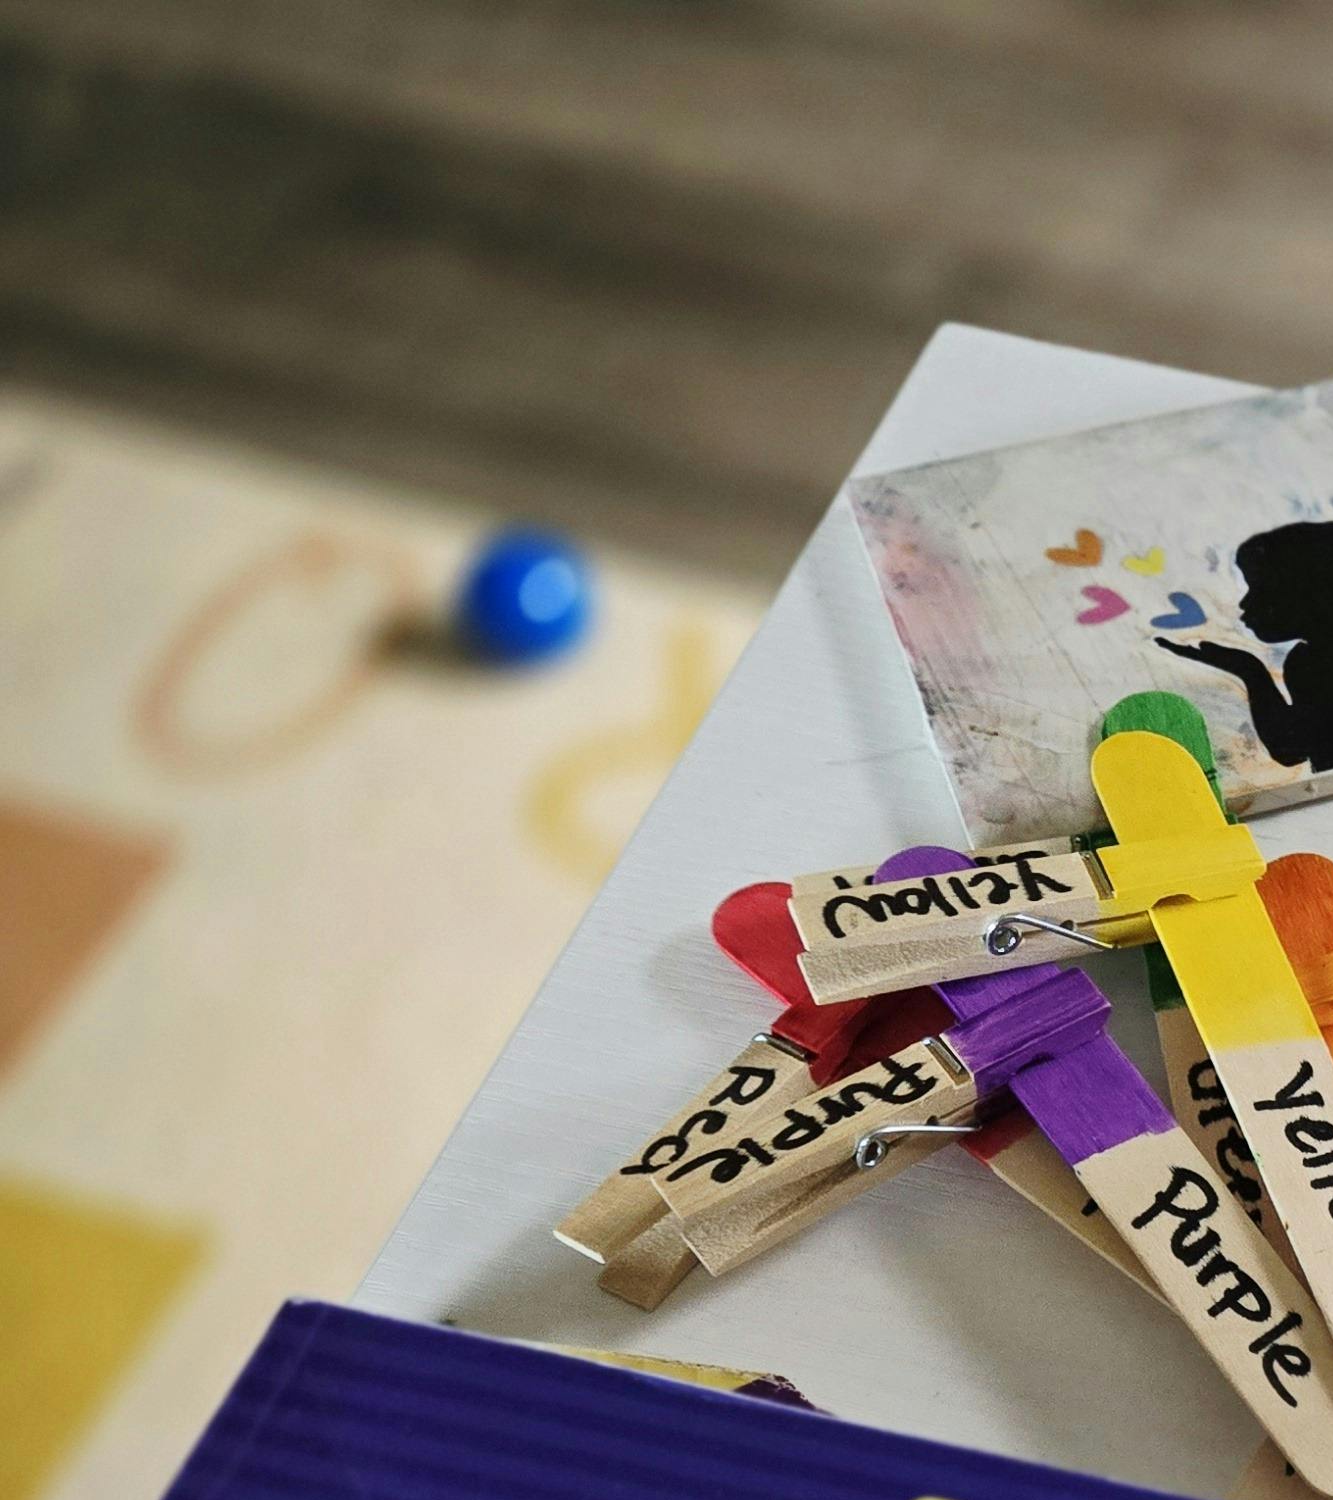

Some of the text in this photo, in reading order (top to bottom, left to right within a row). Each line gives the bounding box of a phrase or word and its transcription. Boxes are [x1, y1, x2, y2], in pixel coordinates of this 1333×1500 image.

[822, 858, 1073, 939] Yellow
[619, 1065, 776, 1175] Red
[666, 1057, 939, 1184] Purple
[1130, 1163, 1312, 1408] Purple
